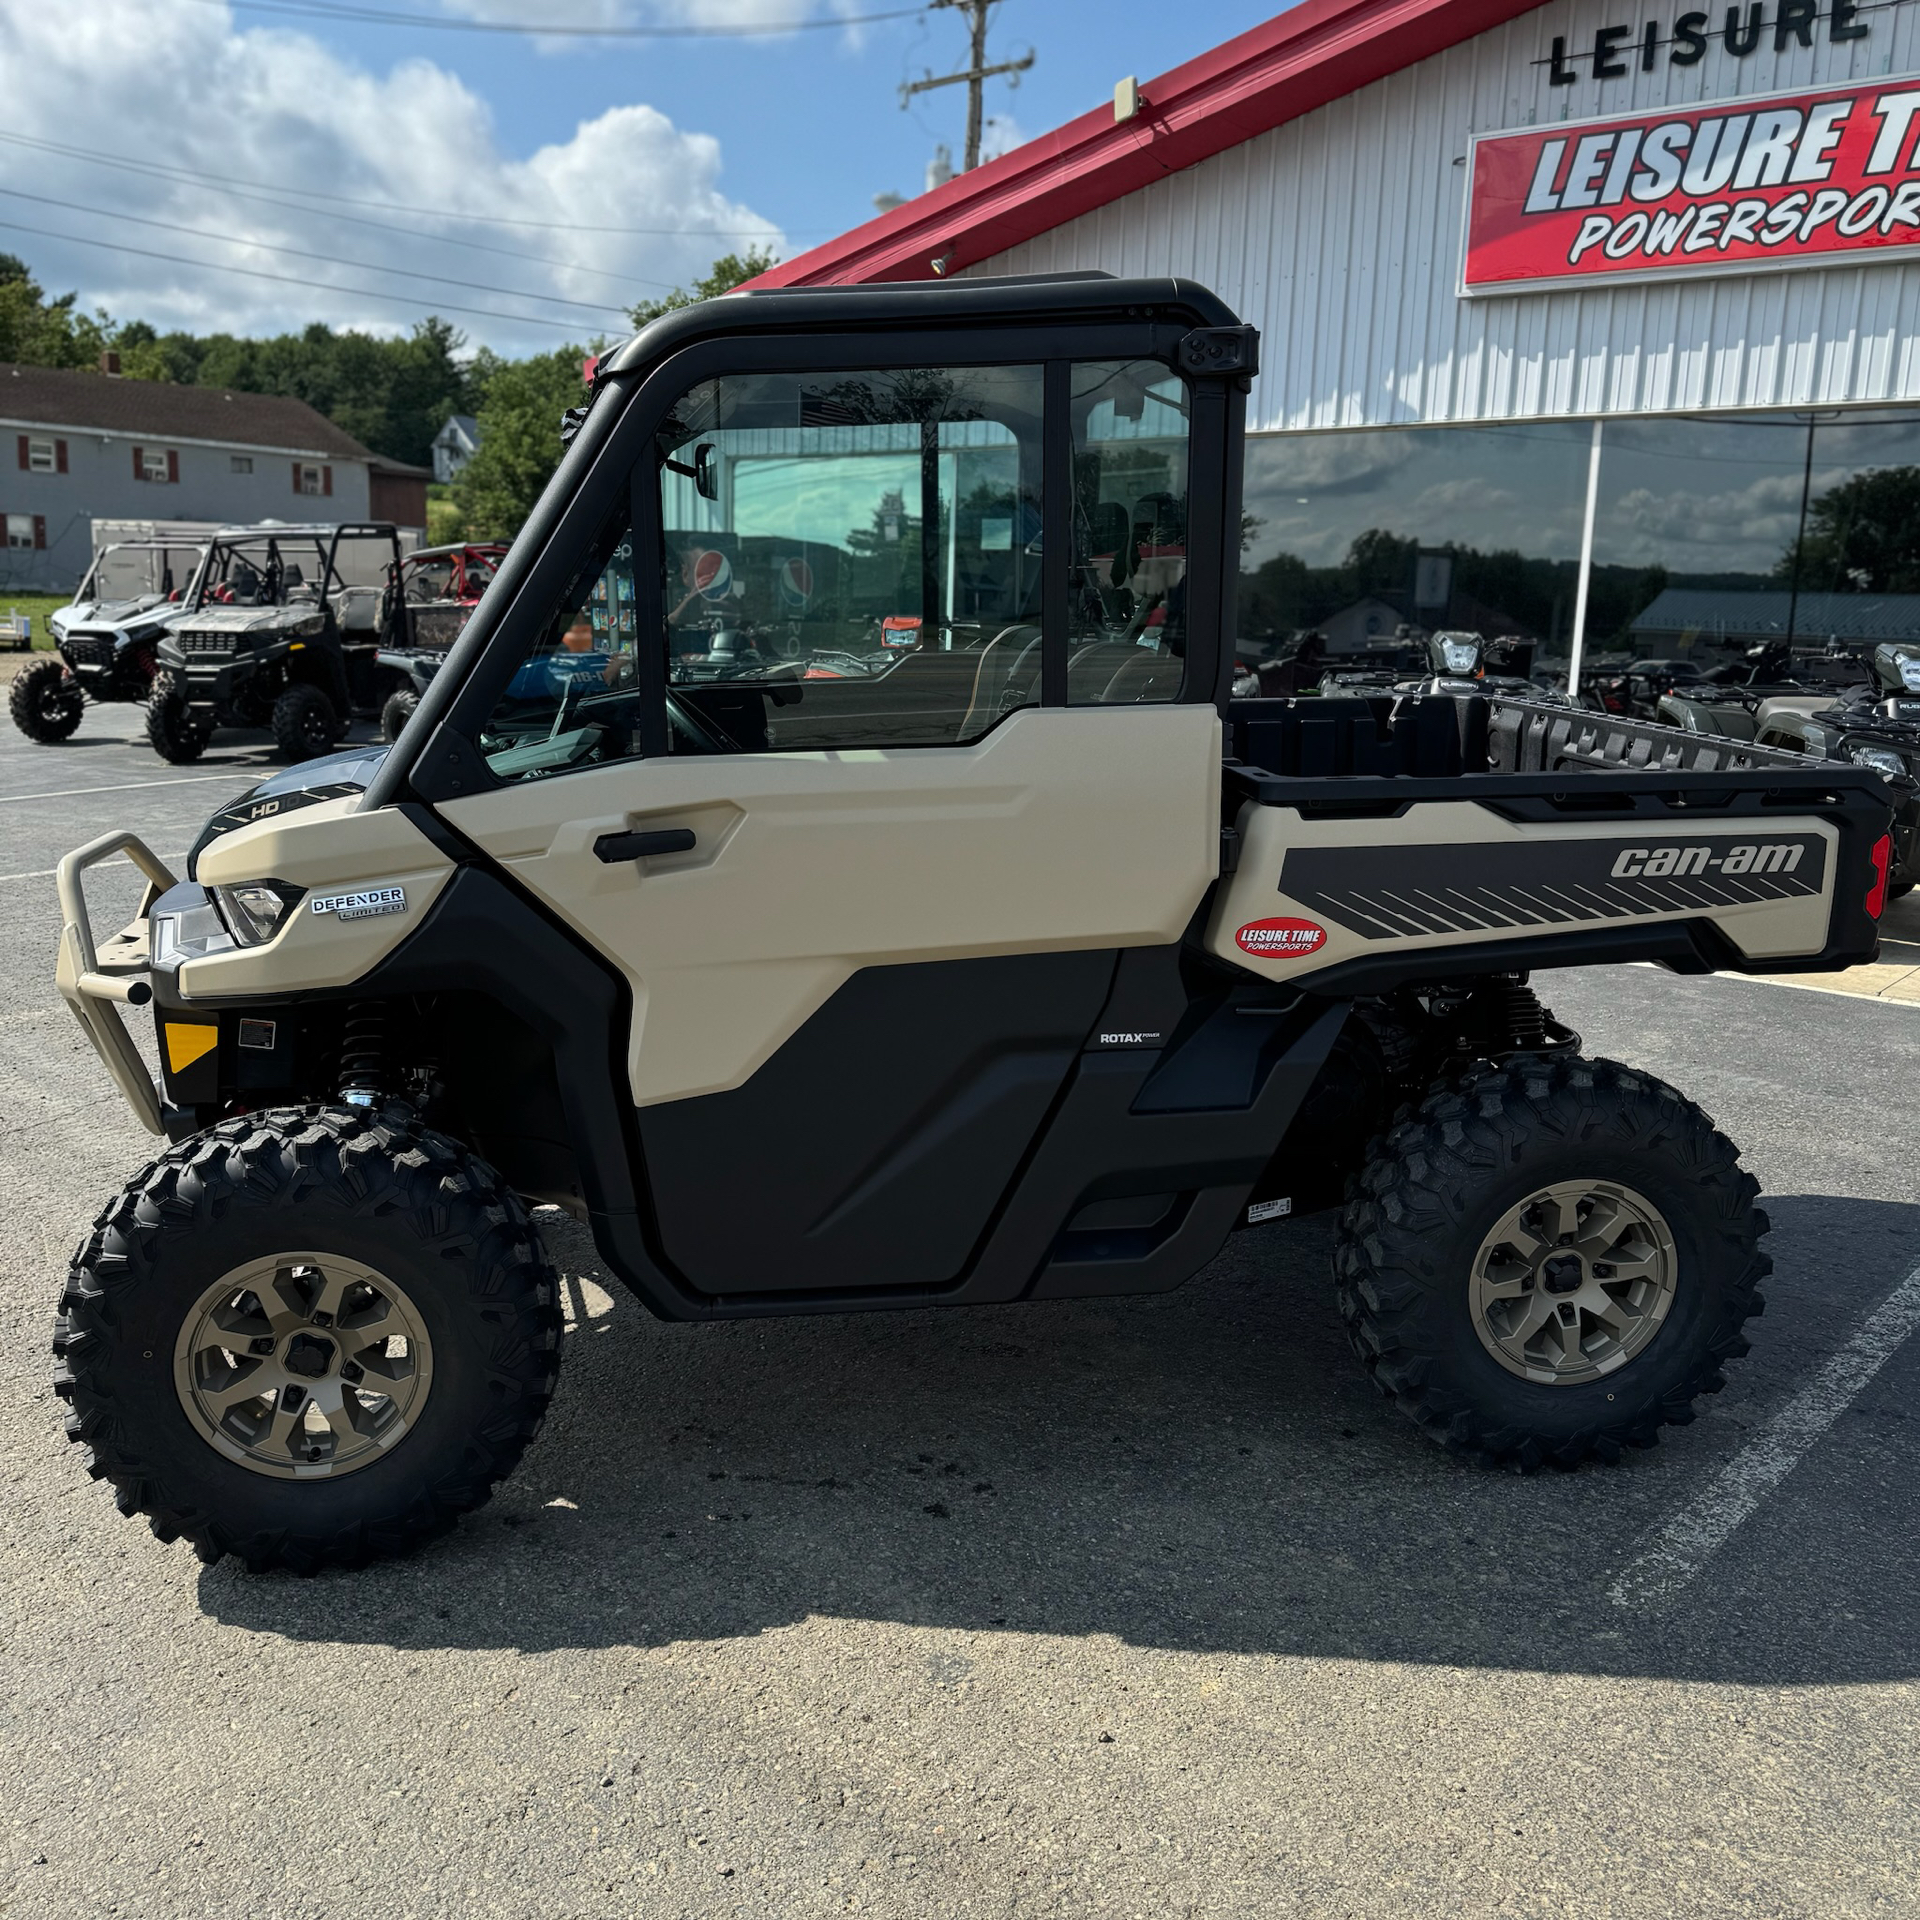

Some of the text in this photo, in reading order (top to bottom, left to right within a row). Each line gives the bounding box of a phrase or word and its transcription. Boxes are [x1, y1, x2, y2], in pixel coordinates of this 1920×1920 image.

[1549, 0, 1869, 86] LEISURE
[1523, 99, 1854, 214] LEISURE
[1610, 844, 1805, 878] can-am
[313, 888, 402, 912] DEFENDER
[342, 904, 401, 918] LIMITED
[1240, 929, 1321, 942] LEISURE TIME
[1246, 942, 1314, 951] POWERSPORTS
[1100, 1033, 1142, 1043] ROTAX
